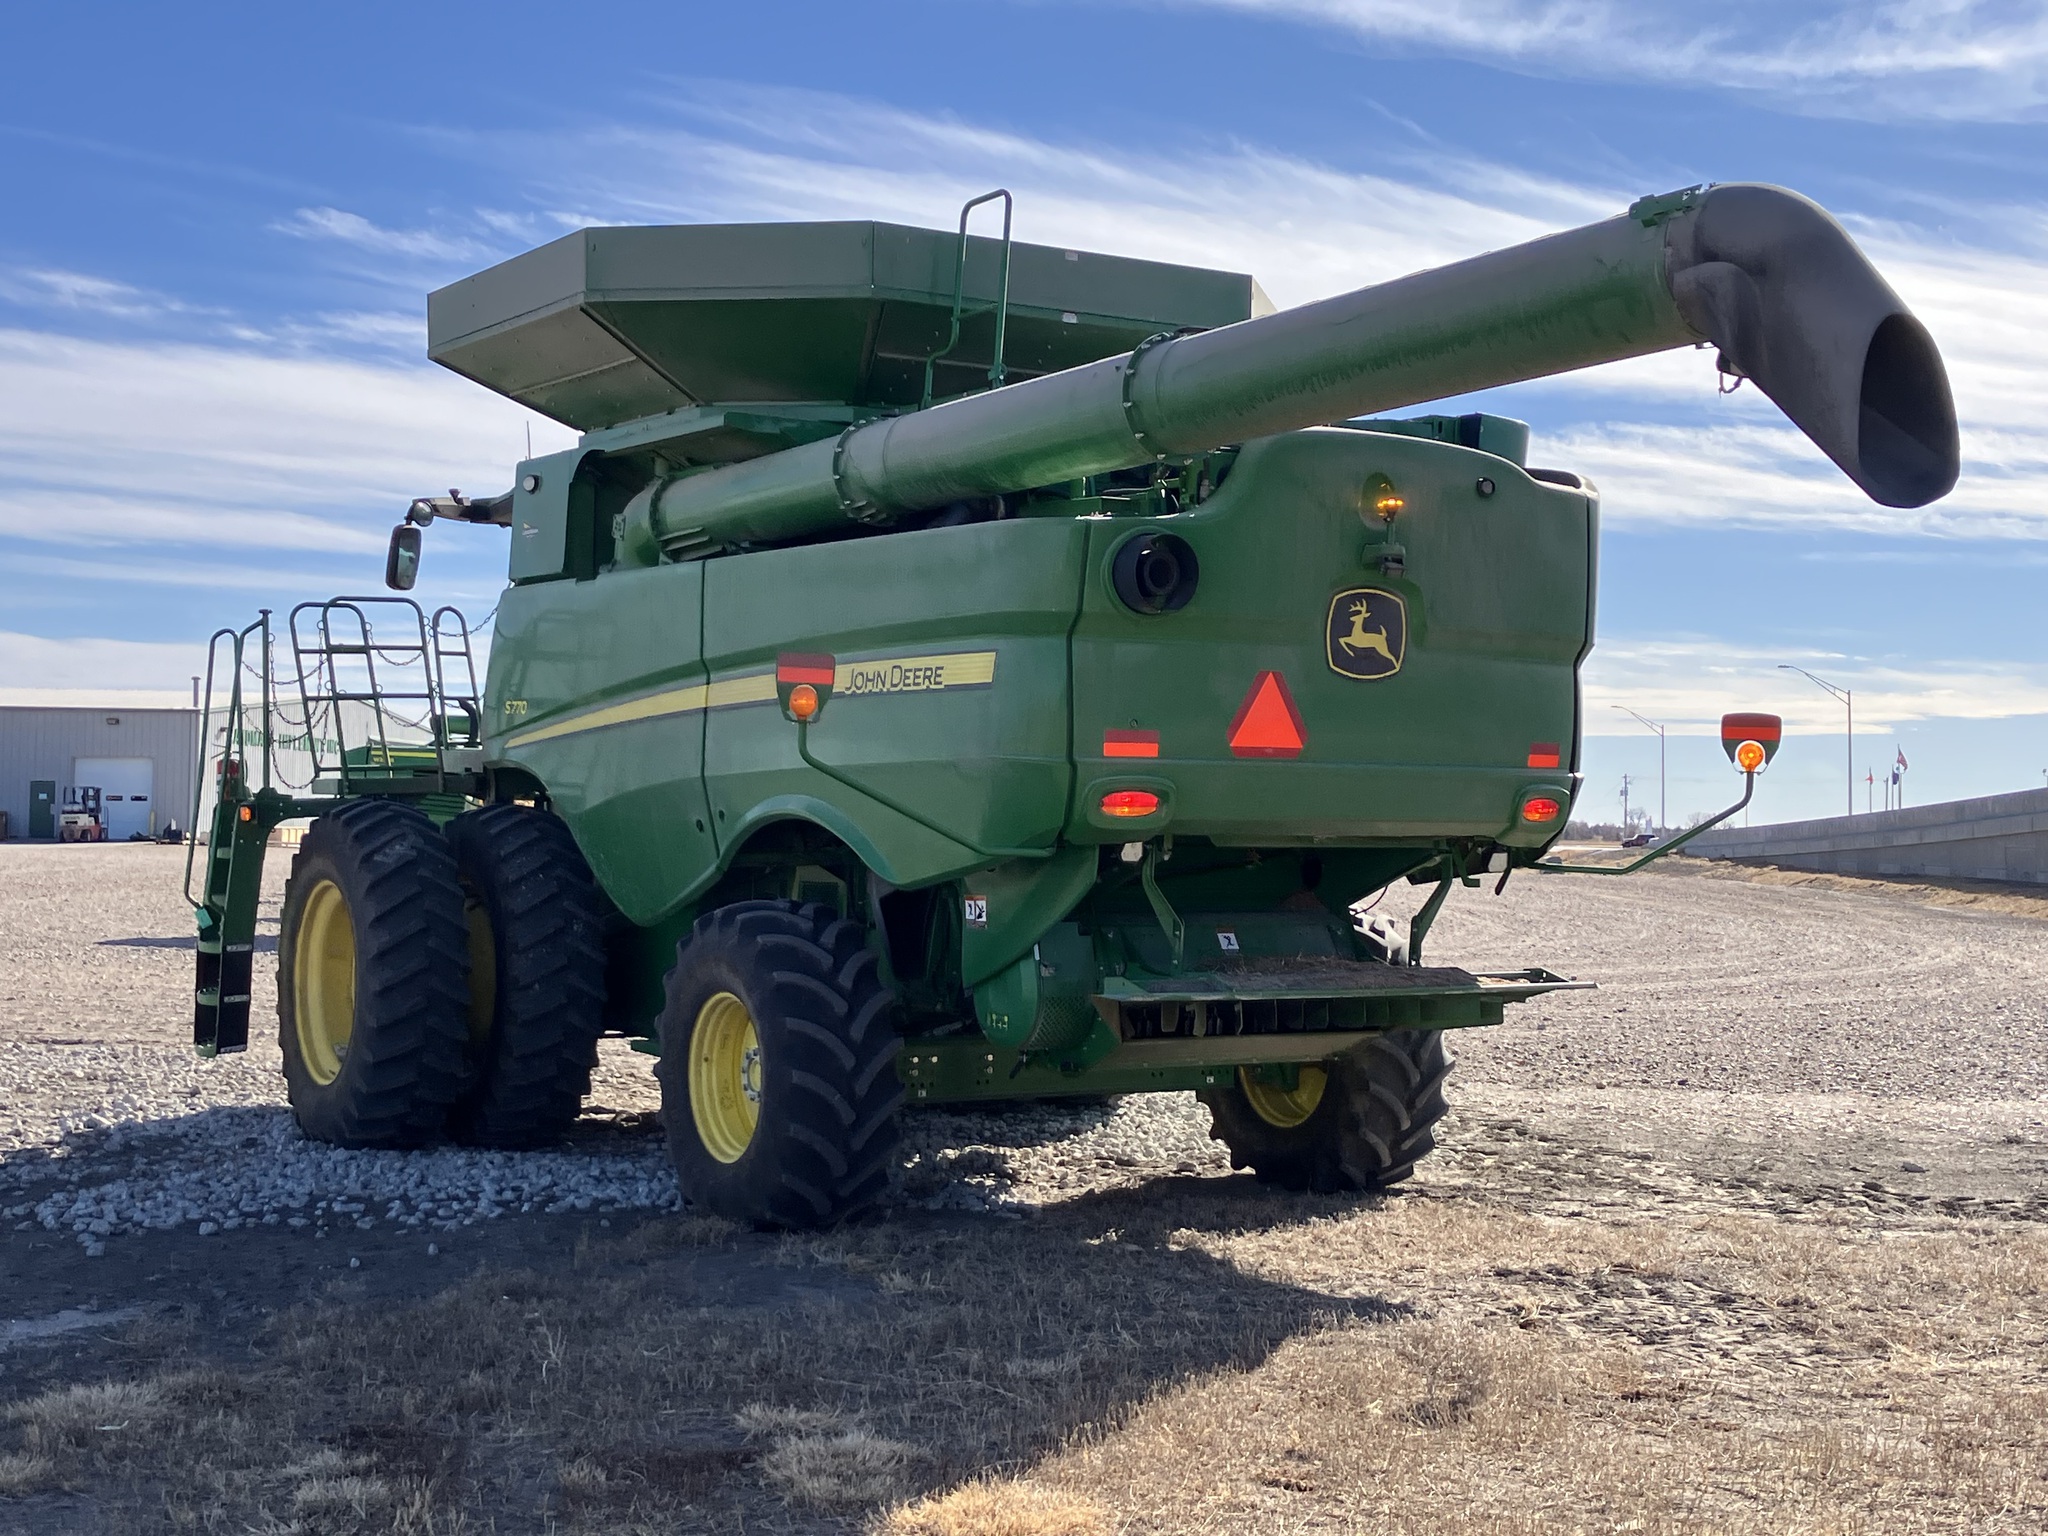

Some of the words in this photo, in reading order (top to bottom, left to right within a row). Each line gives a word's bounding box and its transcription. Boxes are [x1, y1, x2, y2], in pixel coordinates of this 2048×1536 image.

[845, 668, 887, 691] JOHN
[891, 665, 944, 688] DEERE
[505, 700, 528, 715] S770
